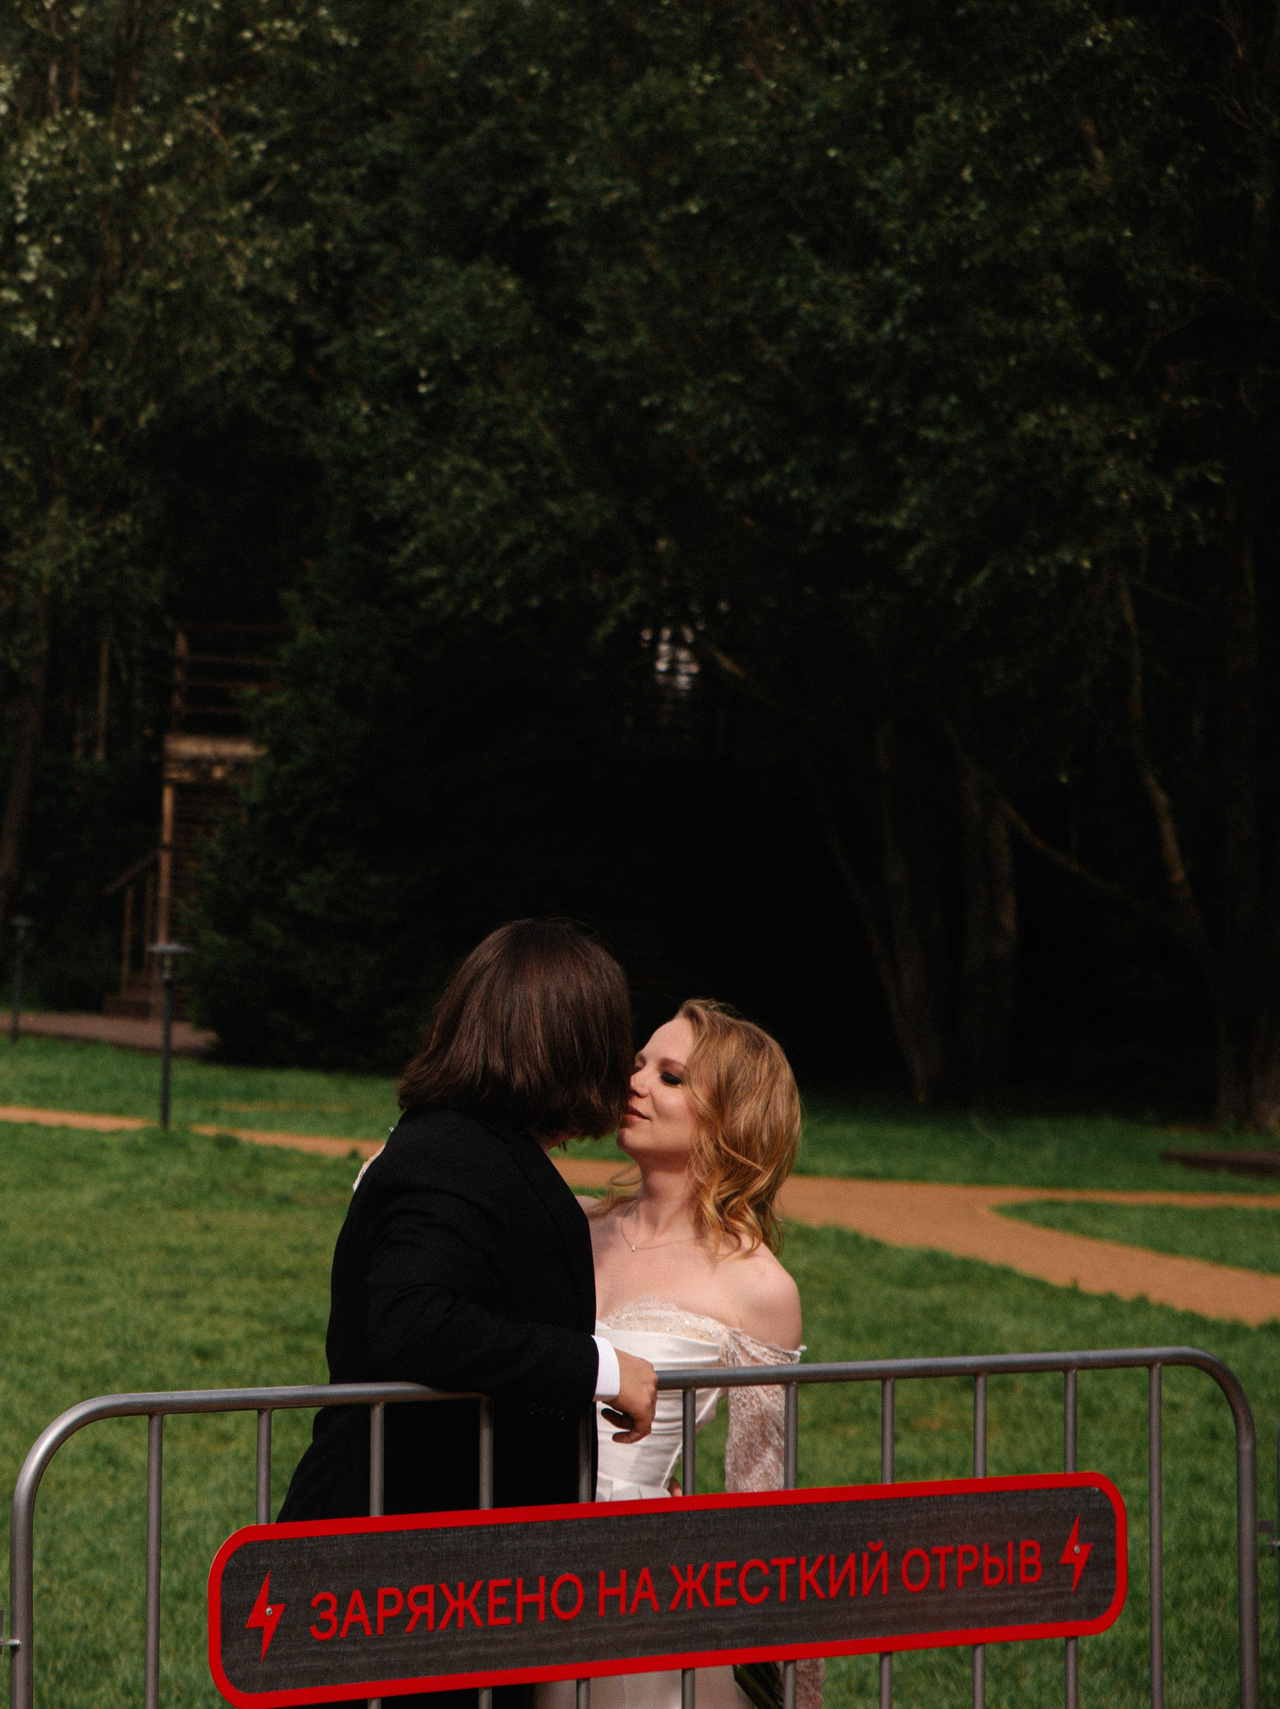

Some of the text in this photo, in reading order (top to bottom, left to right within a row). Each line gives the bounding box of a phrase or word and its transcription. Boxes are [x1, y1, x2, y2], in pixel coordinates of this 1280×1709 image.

[309, 1539, 1043, 1641] ЗАРЯЖЕНО НА ЖЕСТКИЙ ОТРЫВ
